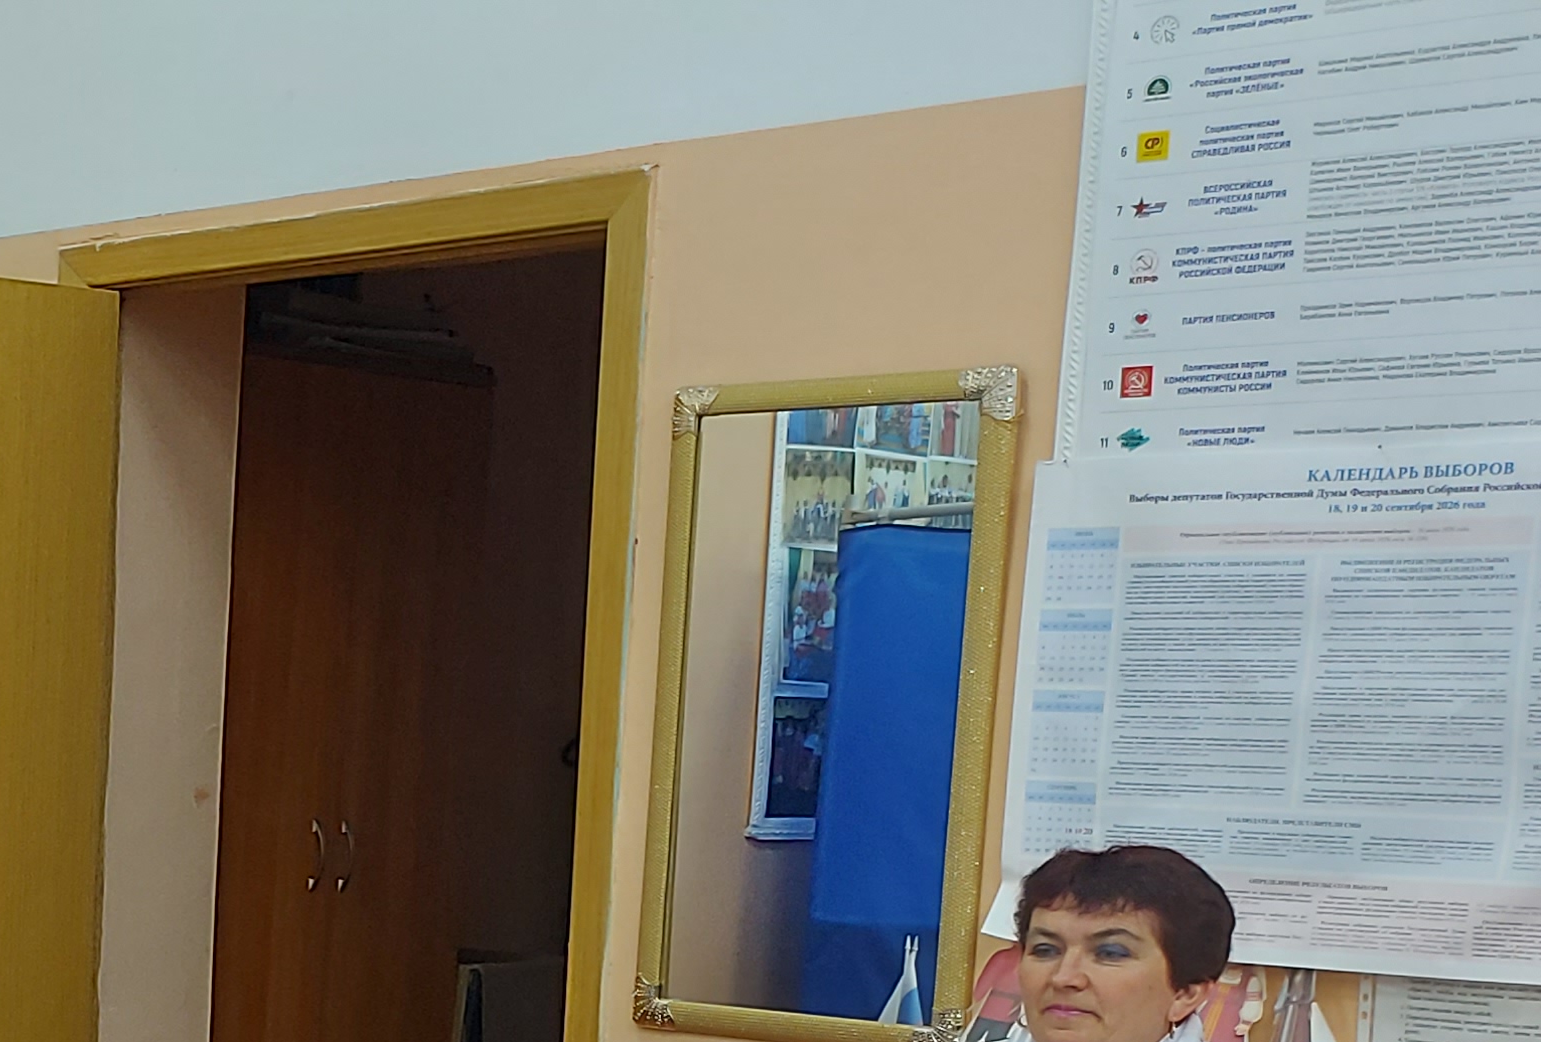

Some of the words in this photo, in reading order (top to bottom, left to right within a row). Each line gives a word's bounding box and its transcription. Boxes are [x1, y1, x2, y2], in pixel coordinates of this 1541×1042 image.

[1133, 31, 1140, 41] 4
[1126, 88, 1133, 100] 5
[1120, 146, 1127, 158] 6
[1257, 140, 1292, 153] РОССИЯ
[1203, 179, 1273, 194] ВСЕРОССИЙСКАЯ
[1188, 193, 1253, 207] ПОЛИТИЧЕСКАЯ
[1254, 189, 1287, 201] ПАРТИЯ
[1116, 205, 1123, 217] 7
[1261, 249, 1294, 261] ПАРТИЯ
[1112, 265, 1119, 276] 8
[1128, 275, 1159, 285] КПРФ
[1182, 314, 1214, 326] ПАРТИЯ
[1215, 311, 1276, 324] ПЕНСИОНЕРОВ
[1108, 322, 1115, 333] 9
[1163, 371, 1253, 385] КОММУНИСТИЧЕСКАЯ
[1253, 369, 1287, 380] ПАРТИЯ
[1102, 379, 1114, 391] 10
[1176, 383, 1237, 396] КОММУНИСТЫ
[1238, 382, 1272, 393] РОССИИ
[1100, 437, 1109, 448] 11
[1307, 466, 1419, 483] КАЛЕНДАРЬ
[1423, 462, 1515, 479] ВЫБОРОВ
[1129, 493, 1170, 504] Выборы
[1171, 492, 1223, 503] депутатов
[1225, 489, 1314, 503] Государственной
[1316, 487, 1348, 499] Думы
[1349, 485, 1425, 499] Федерального
[1426, 484, 1480, 496] Собрания
[1346, 503, 1358, 513] 19
[1370, 503, 1383, 512] 20
[1385, 501, 1435, 513] сентября
[1436, 500, 1460, 510] 2026
[1462, 501, 1486, 510] года
